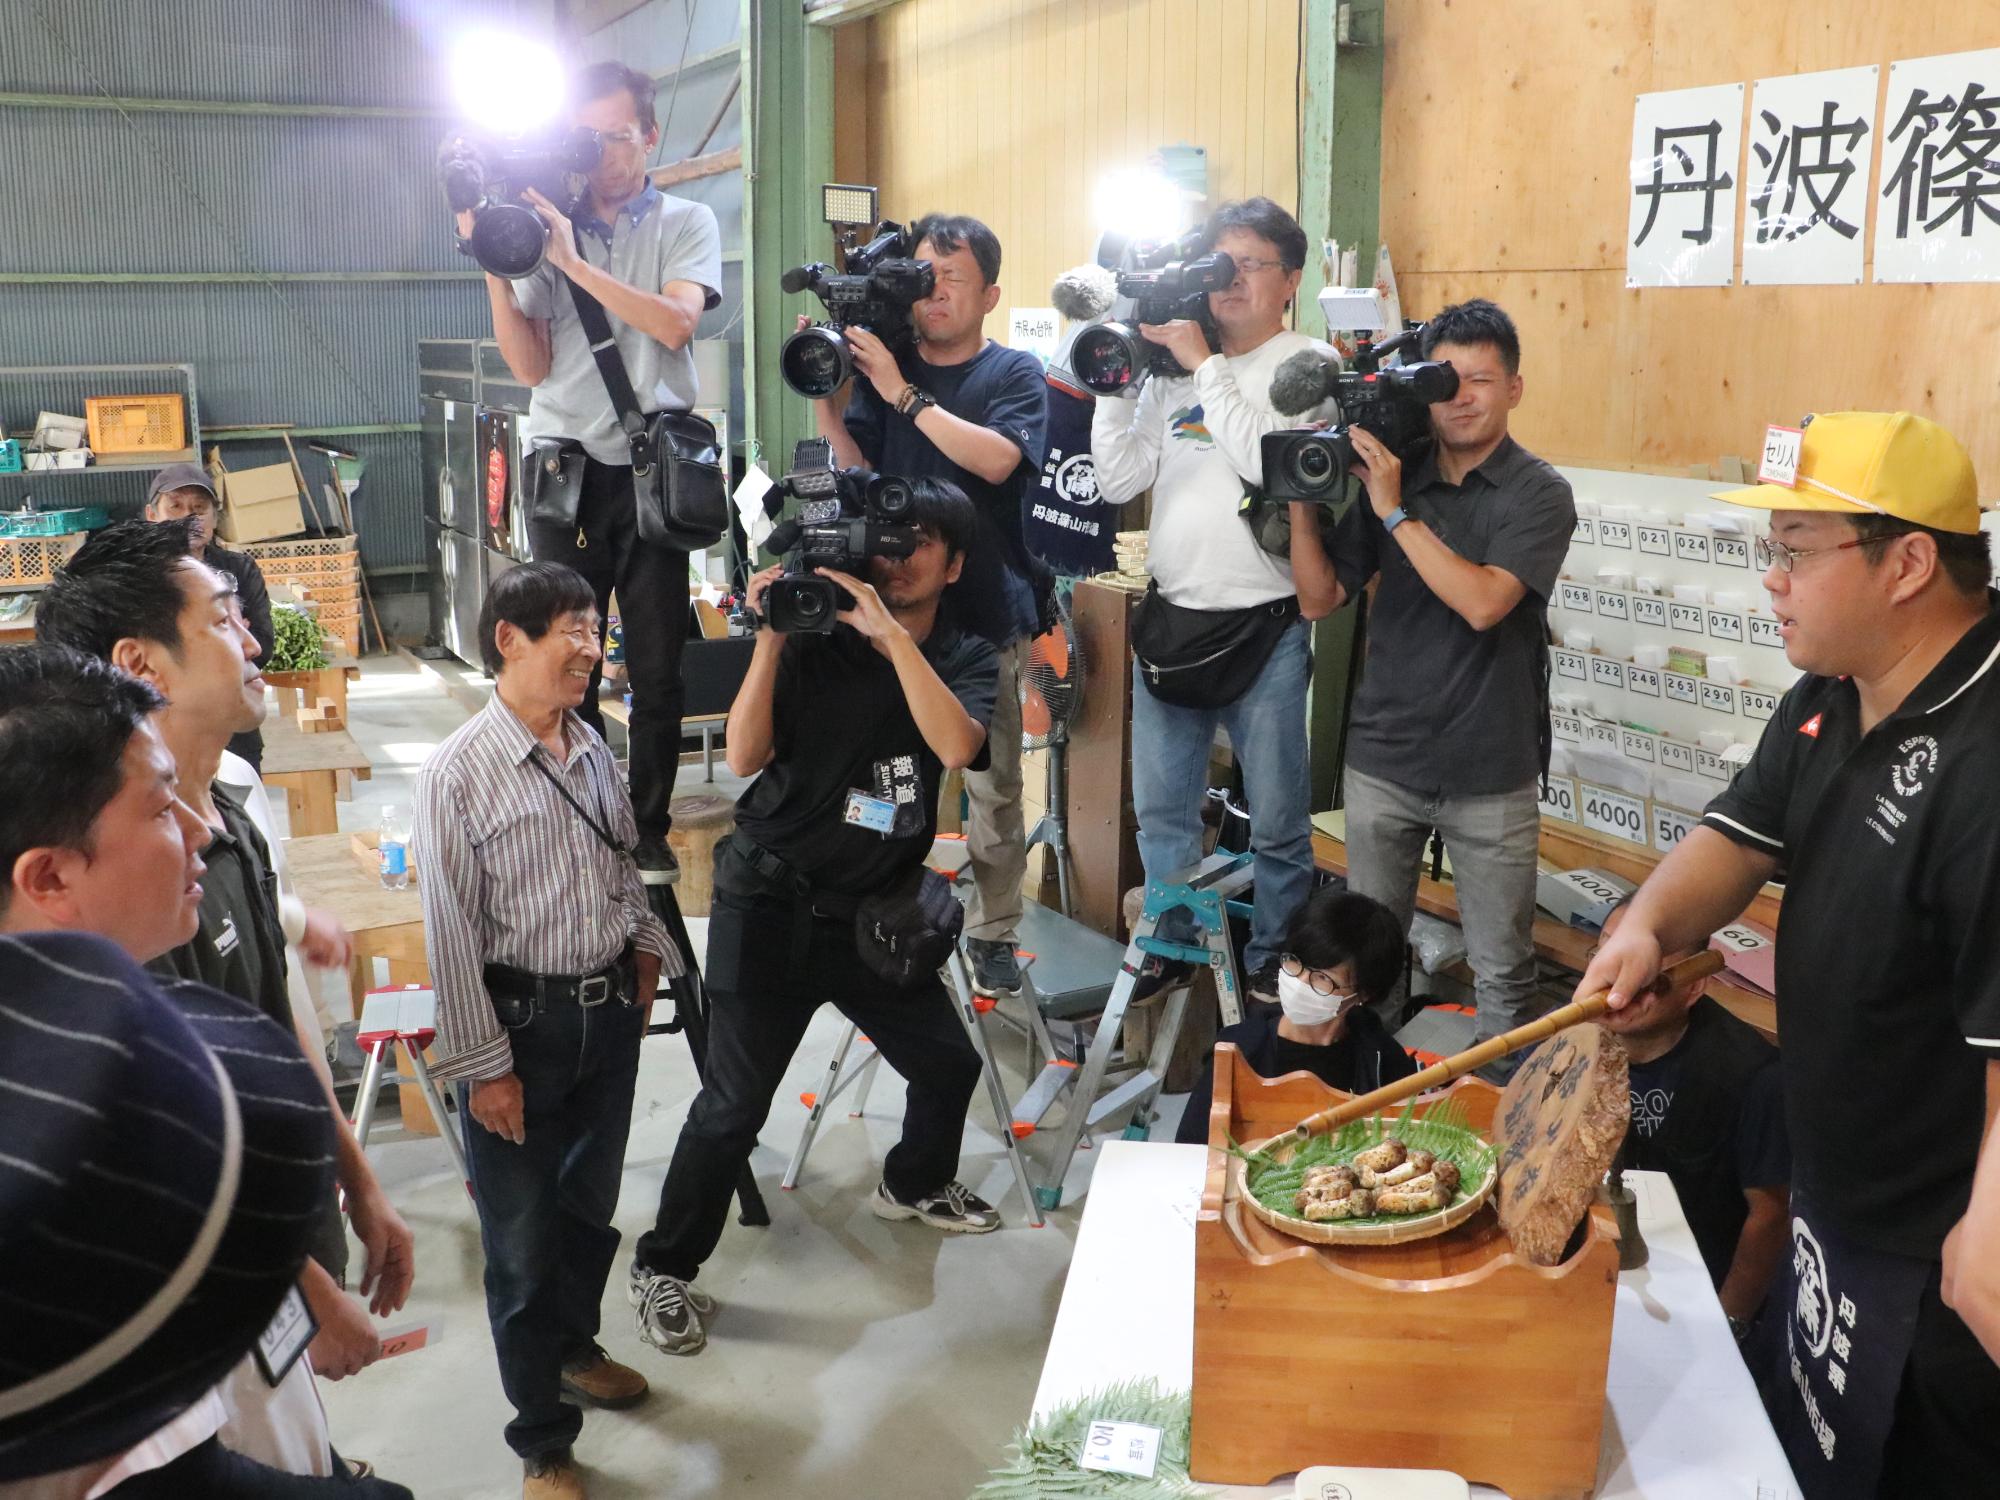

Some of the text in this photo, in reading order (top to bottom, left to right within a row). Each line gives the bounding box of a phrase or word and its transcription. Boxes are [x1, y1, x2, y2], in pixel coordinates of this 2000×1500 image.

[1633, 82, 2000, 248] 丹波篠
[1014, 319, 1053, 338] 市民の台所
[1766, 442, 1795, 469] セリ人
[1032, 503, 1100, 537] 丹波篠山市場
[1577, 523, 1590, 533] 17
[1602, 525, 1627, 538] 019
[1640, 531, 1666, 544] 021
[1678, 537, 1706, 551] 024
[1716, 542, 1745, 556] 026
[1564, 589, 1589, 602] 068
[1599, 595, 1624, 609] 069
[1636, 601, 1662, 615] 070
[1672, 608, 1699, 622] 072
[1711, 616, 1739, 630] 074
[1752, 622, 1780, 636] 075
[1559, 656, 1582, 670] 221
[1595, 663, 1619, 677] 222
[1631, 671, 1656, 686] 248
[1667, 678, 1694, 693] 263
[1703, 687, 1731, 702] 290
[1745, 696, 1773, 711] 304
[1554, 719, 1579, 733] 965
[1589, 728, 1614, 742] 126
[1626, 736, 1651, 751] 256
[1663, 746, 1688, 760] 601
[1698, 754, 1726, 770] 332
[880, 765, 893, 801] SUN-TV
[891, 755, 917, 806] 報道
[1586, 798, 1641, 832] 4000
[1659, 820, 1688, 843] 50
[1723, 930, 1759, 948] 60
